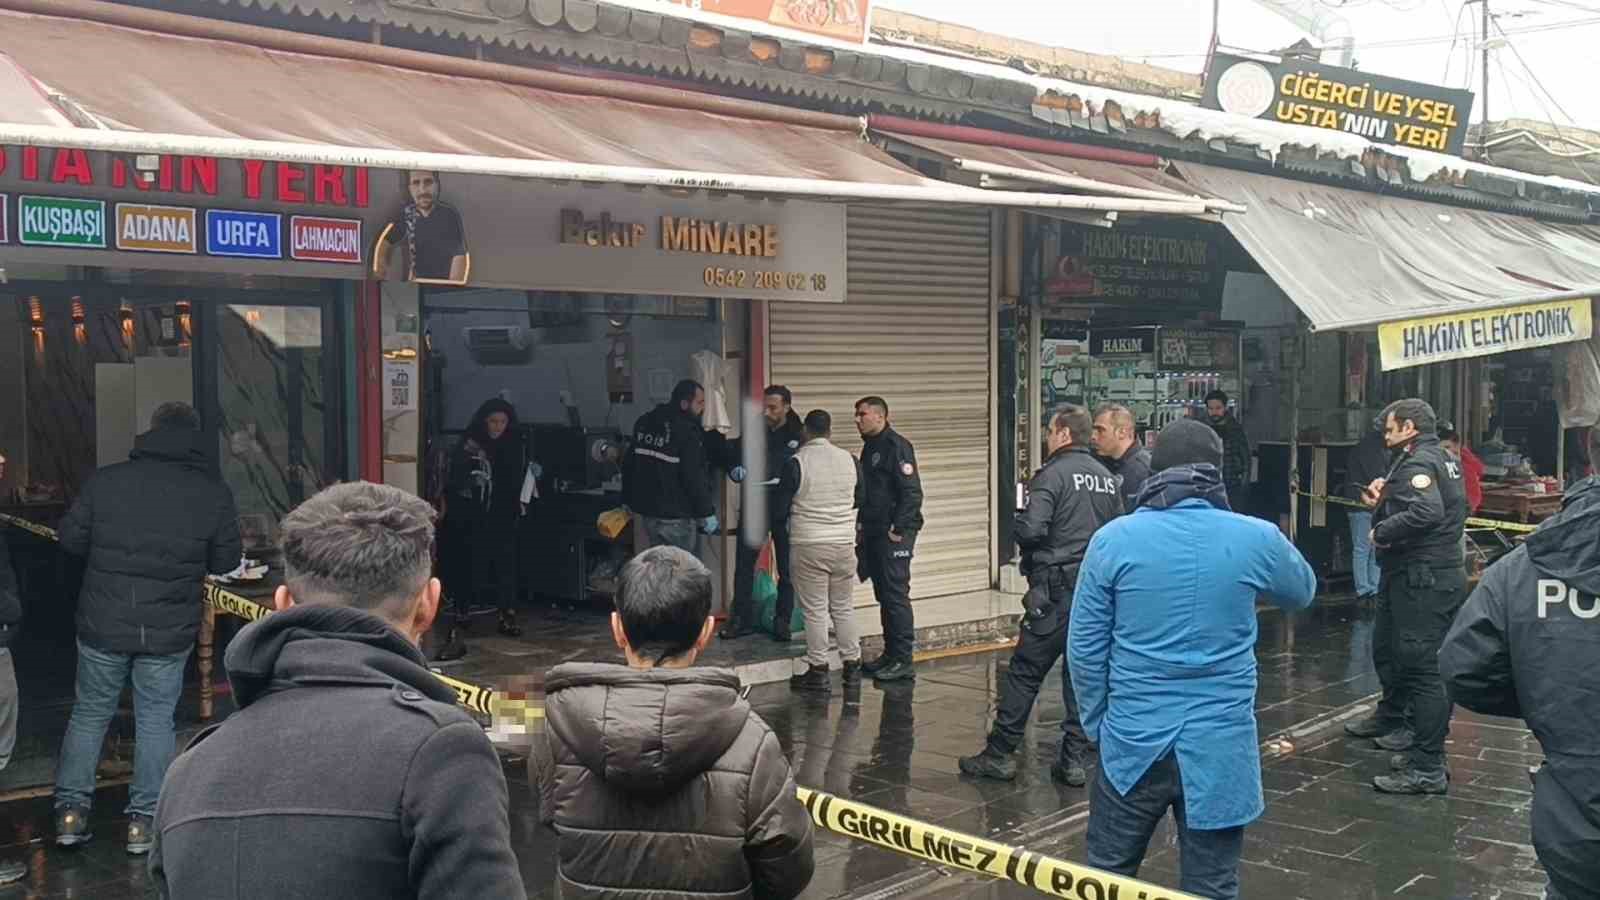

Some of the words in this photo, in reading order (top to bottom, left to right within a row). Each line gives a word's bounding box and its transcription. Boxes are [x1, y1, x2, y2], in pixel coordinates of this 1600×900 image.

[1279, 70, 1371, 109] CİĞERCİ
[1373, 90, 1458, 127] VEYSEL
[1276, 101, 1388, 139] USTA'NIN
[1393, 123, 1449, 150] YERİ
[24, 205, 101, 242] KUŞBAŞI
[122, 213, 190, 242] ADANA
[216, 219, 270, 248] URFA
[295, 225, 358, 253] LAHMACUN
[703, 267, 746, 288] 0542
[754, 270, 782, 289] 209
